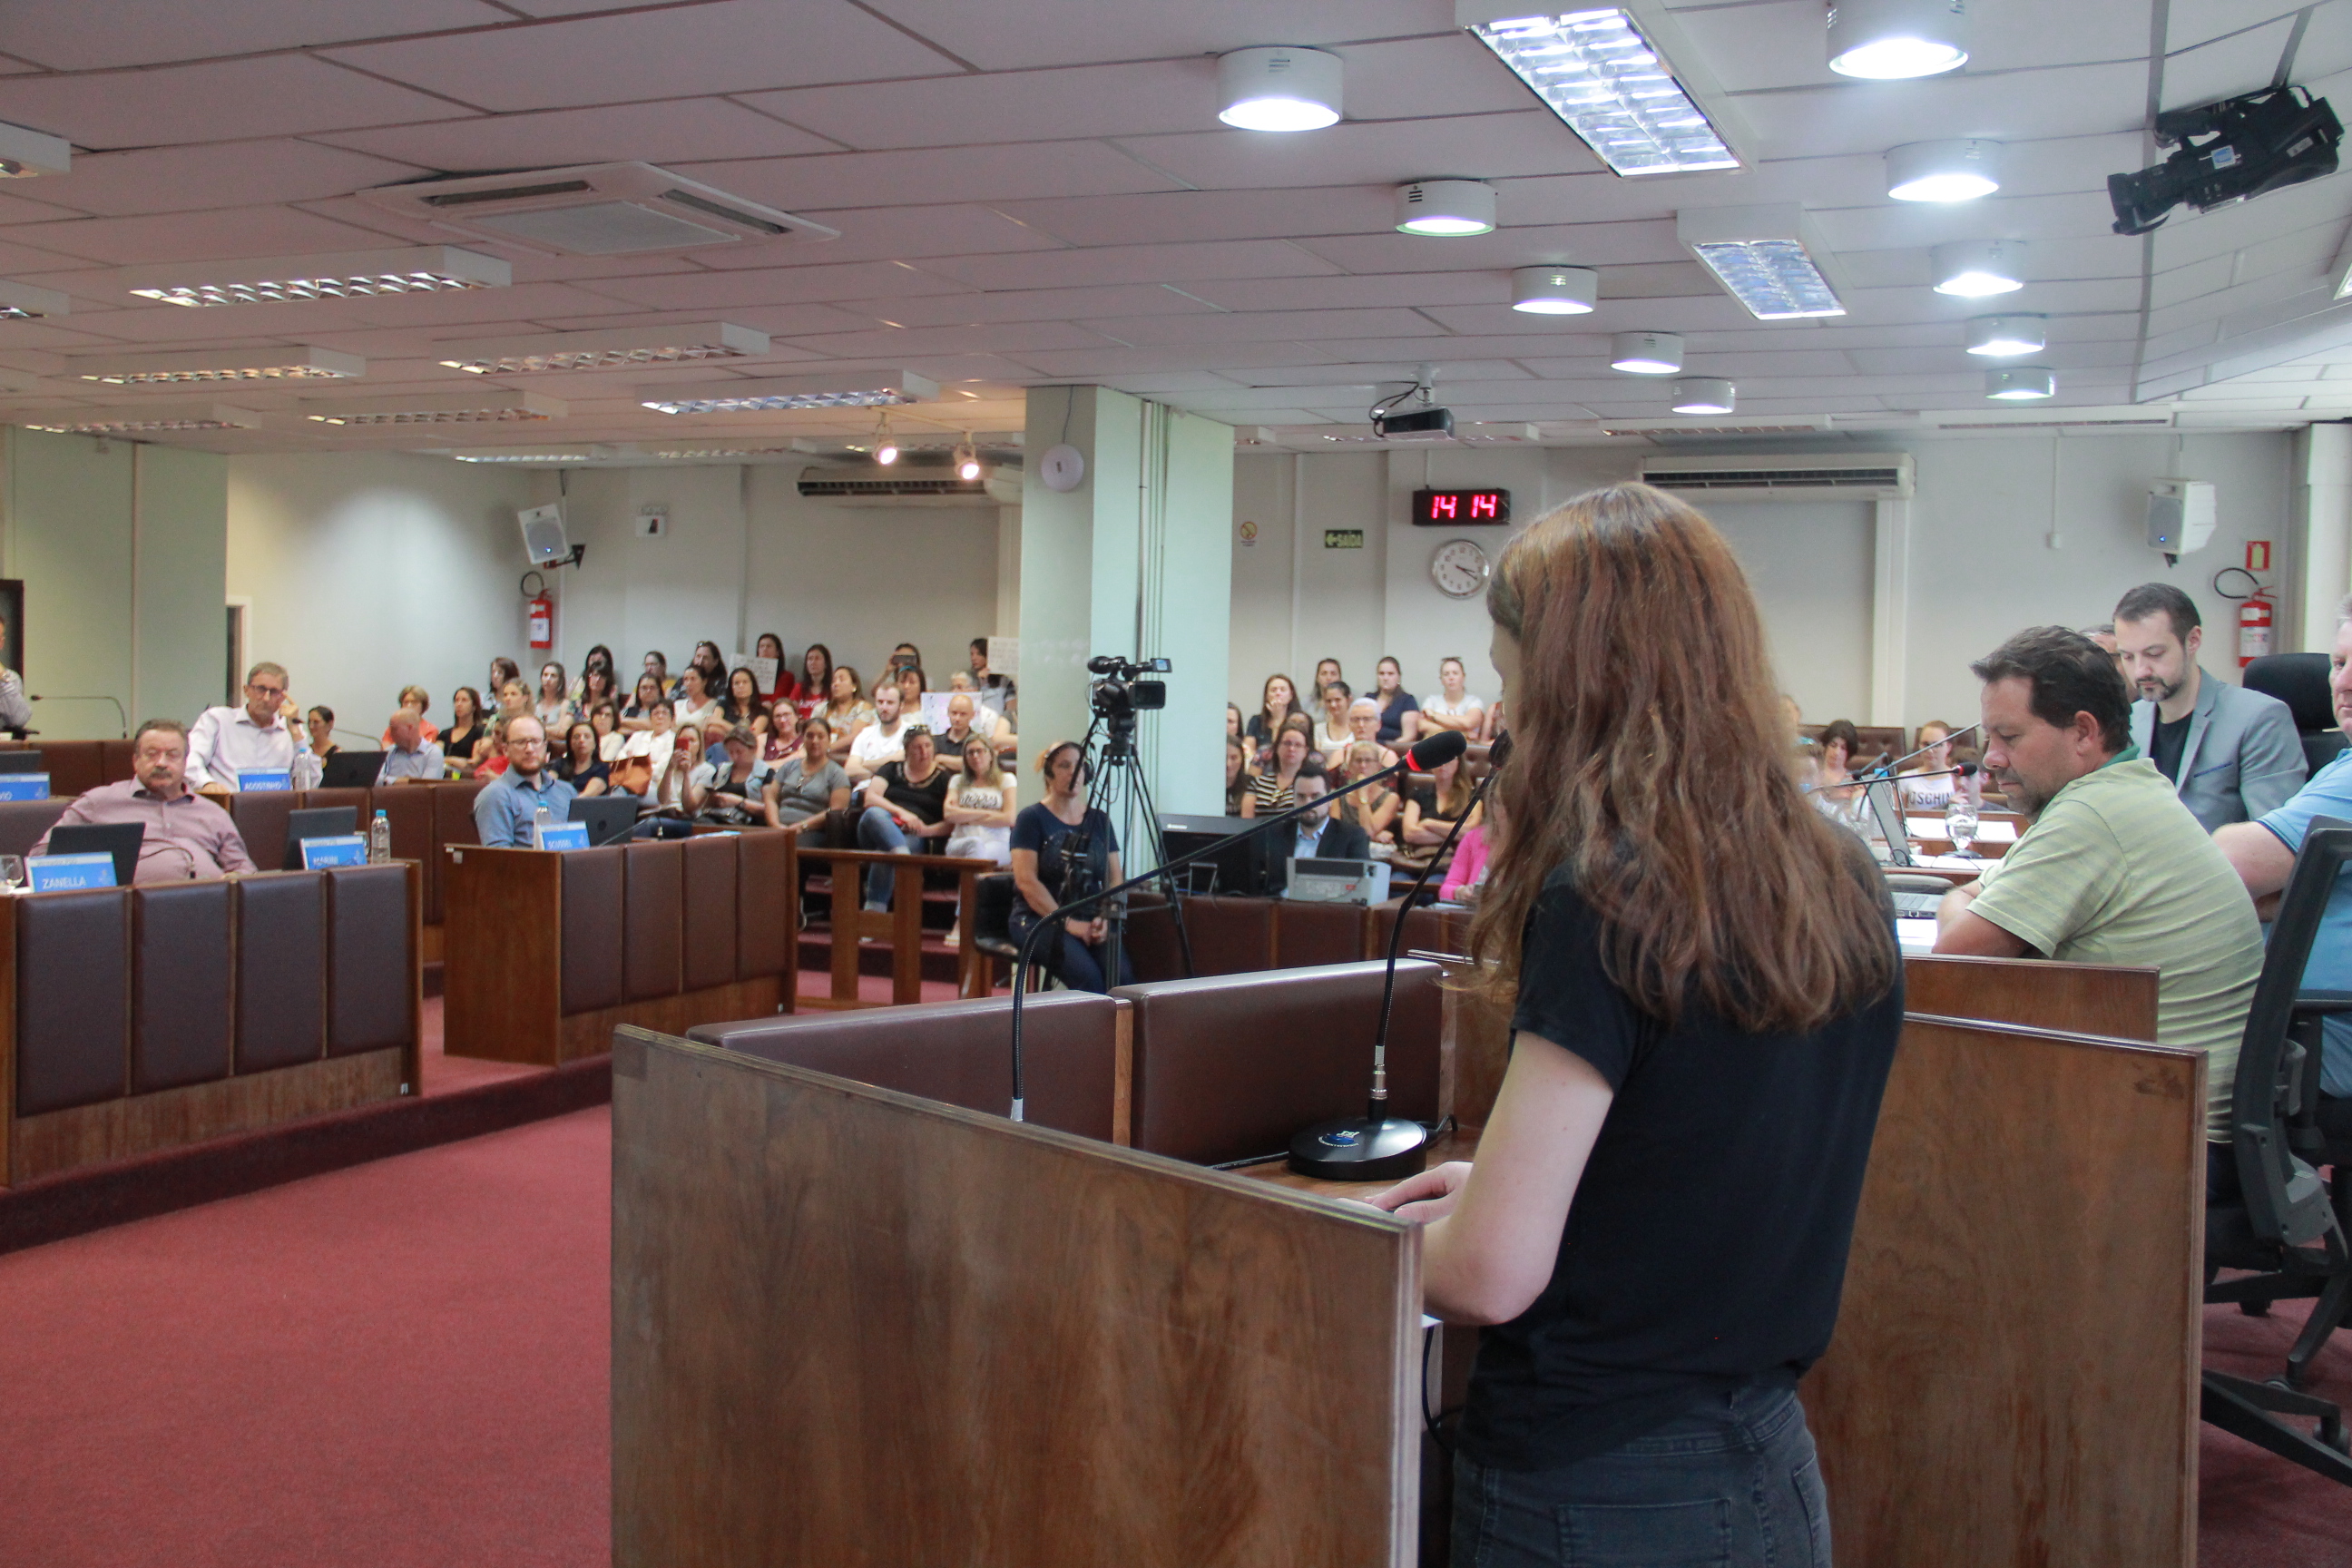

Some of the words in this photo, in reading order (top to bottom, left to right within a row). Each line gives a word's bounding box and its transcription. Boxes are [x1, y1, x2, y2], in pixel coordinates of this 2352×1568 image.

[1431, 495, 1457, 519] 14
[1471, 494, 1498, 518] 14
[42, 876, 87, 889] ZANELLA
